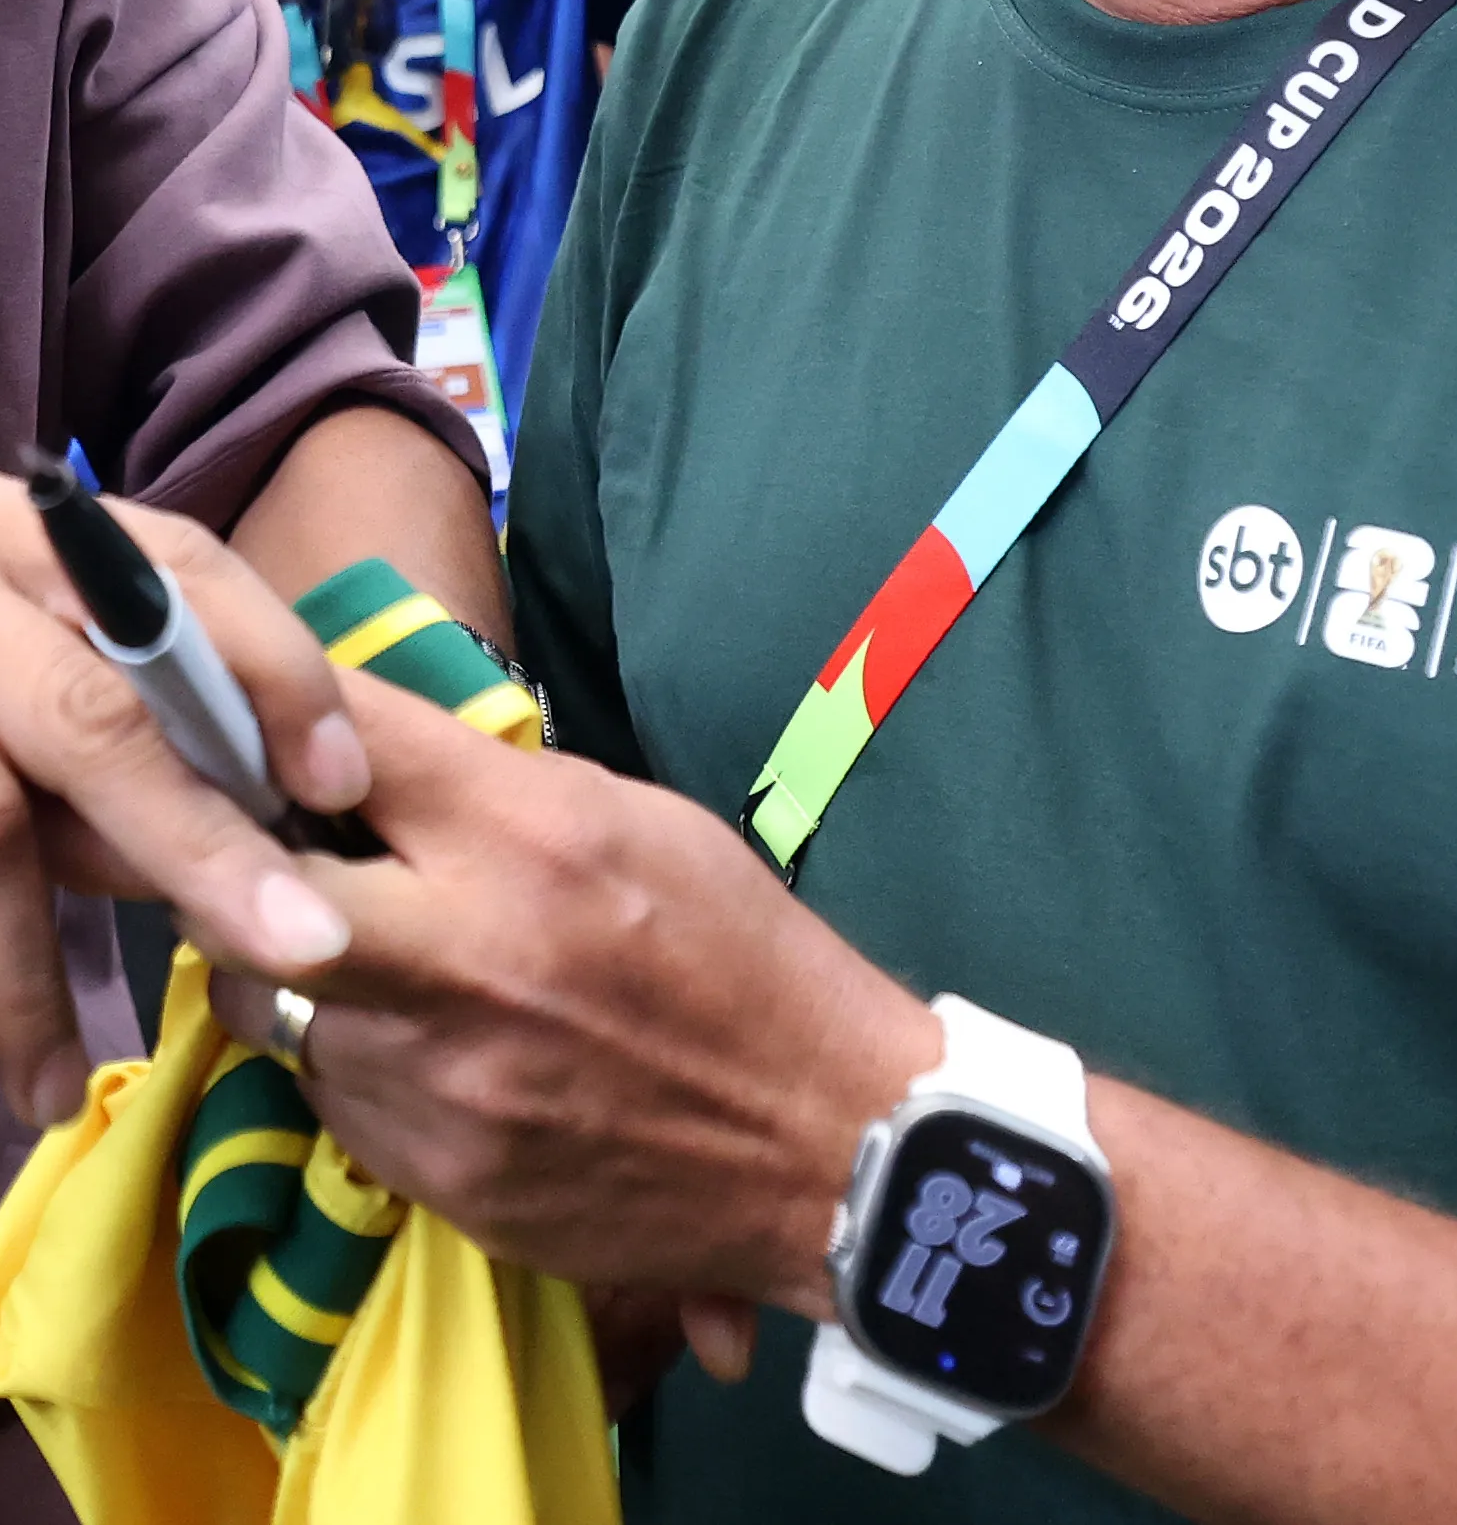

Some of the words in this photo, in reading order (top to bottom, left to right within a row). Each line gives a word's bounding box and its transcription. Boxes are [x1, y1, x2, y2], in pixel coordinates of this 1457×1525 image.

[1266, 41, 1359, 150] CUP
[1205, 525, 1293, 602] sbt
[1348, 631, 1389, 654] FIFA
[905, 1170, 1030, 1268] 28
[879, 1243, 964, 1329] 11
